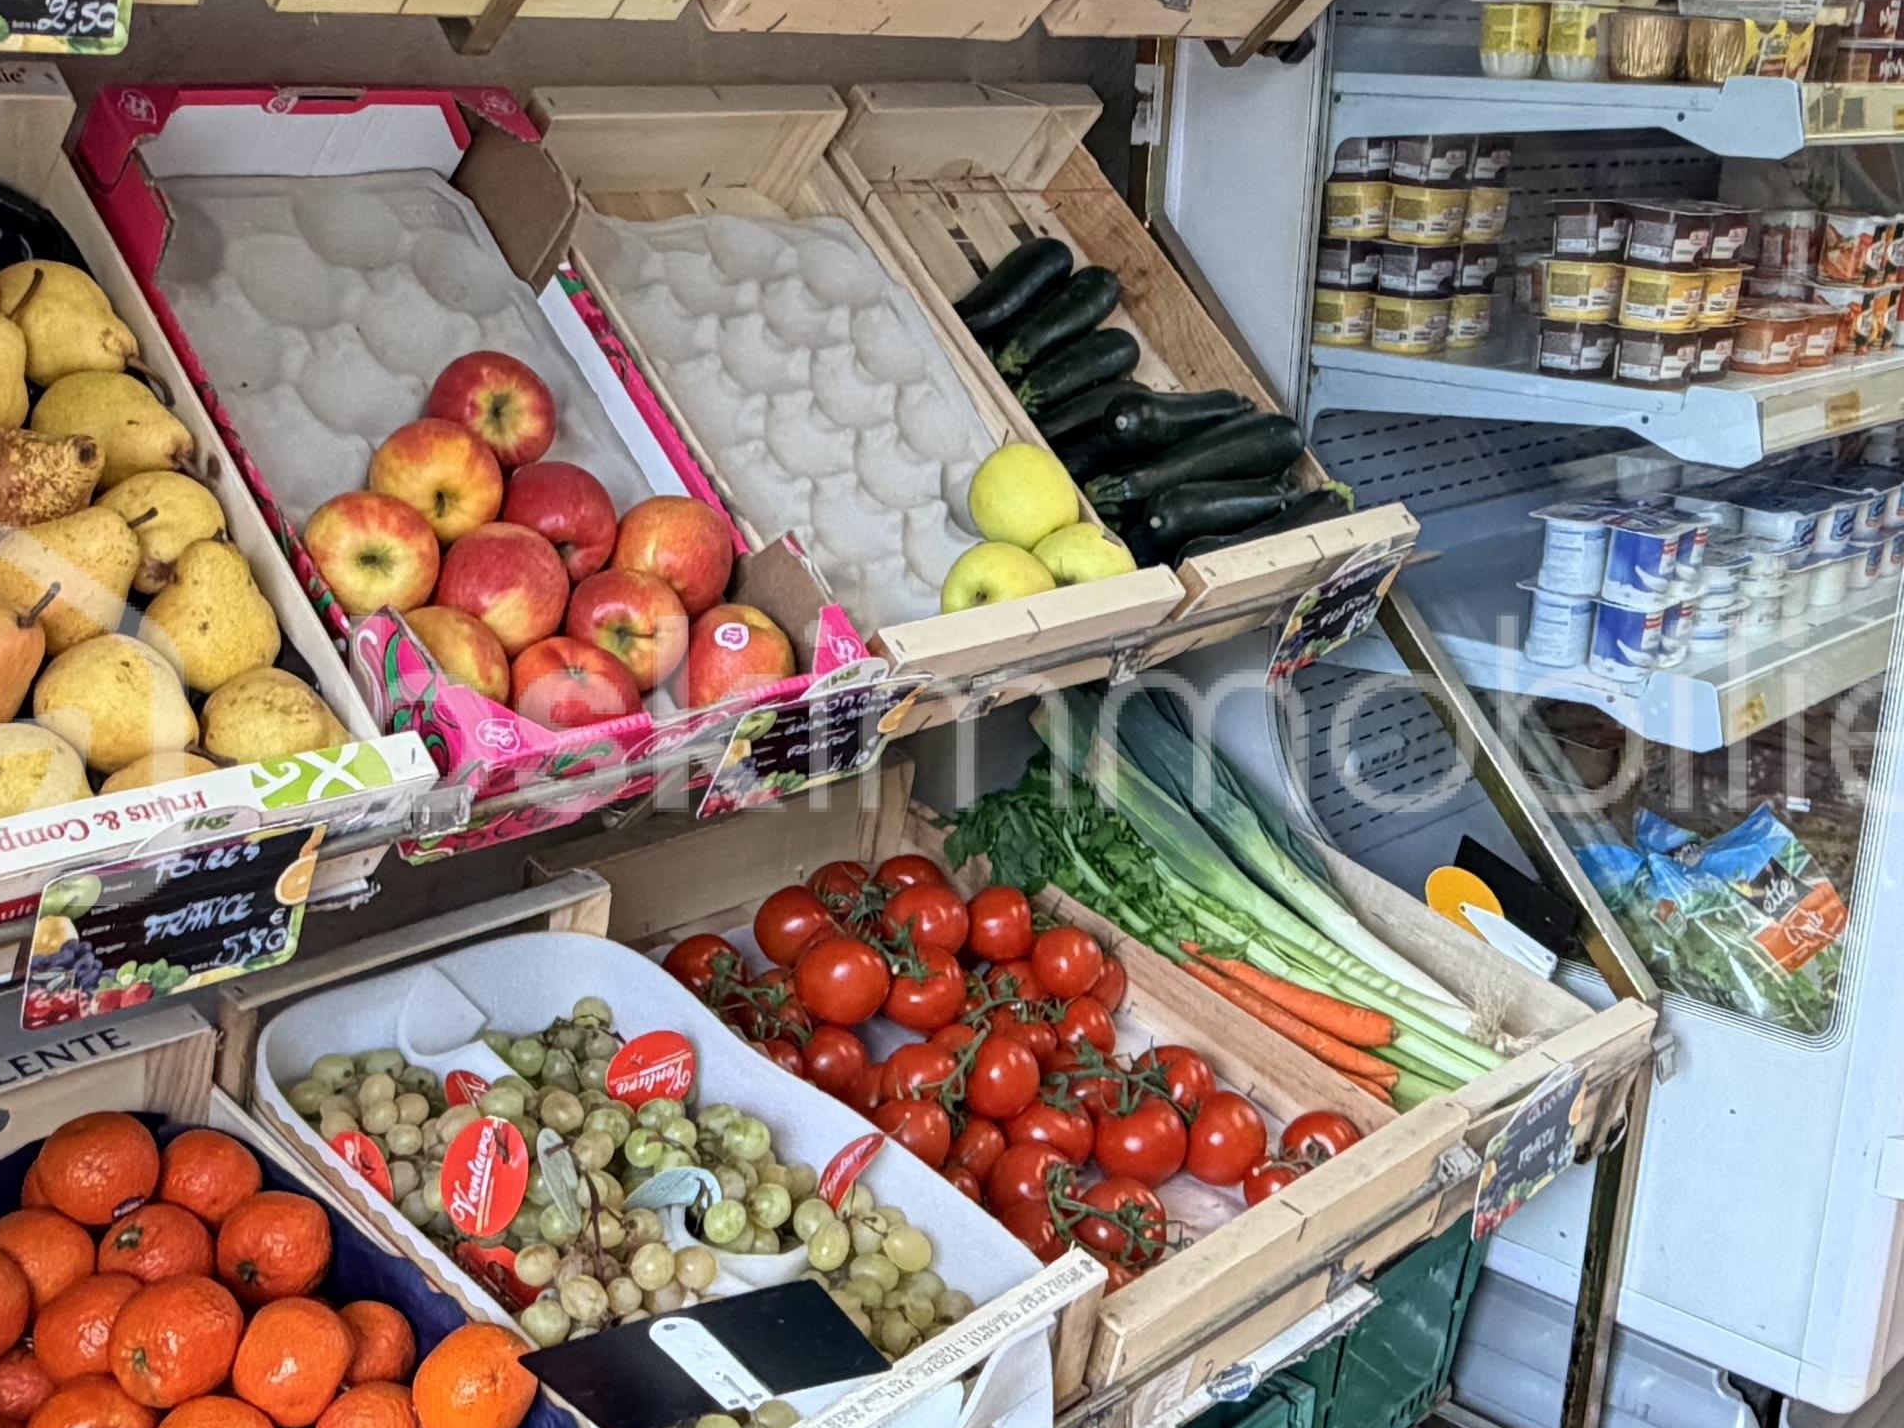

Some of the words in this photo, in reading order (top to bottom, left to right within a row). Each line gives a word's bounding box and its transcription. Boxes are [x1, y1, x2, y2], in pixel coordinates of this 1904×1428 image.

[93, 808, 122, 828] &
[125, 791, 208, 830] Fruits
[146, 841, 262, 884] POIRES
[142, 892, 256, 944] FRANCE
[270, 908, 287, 925] €
